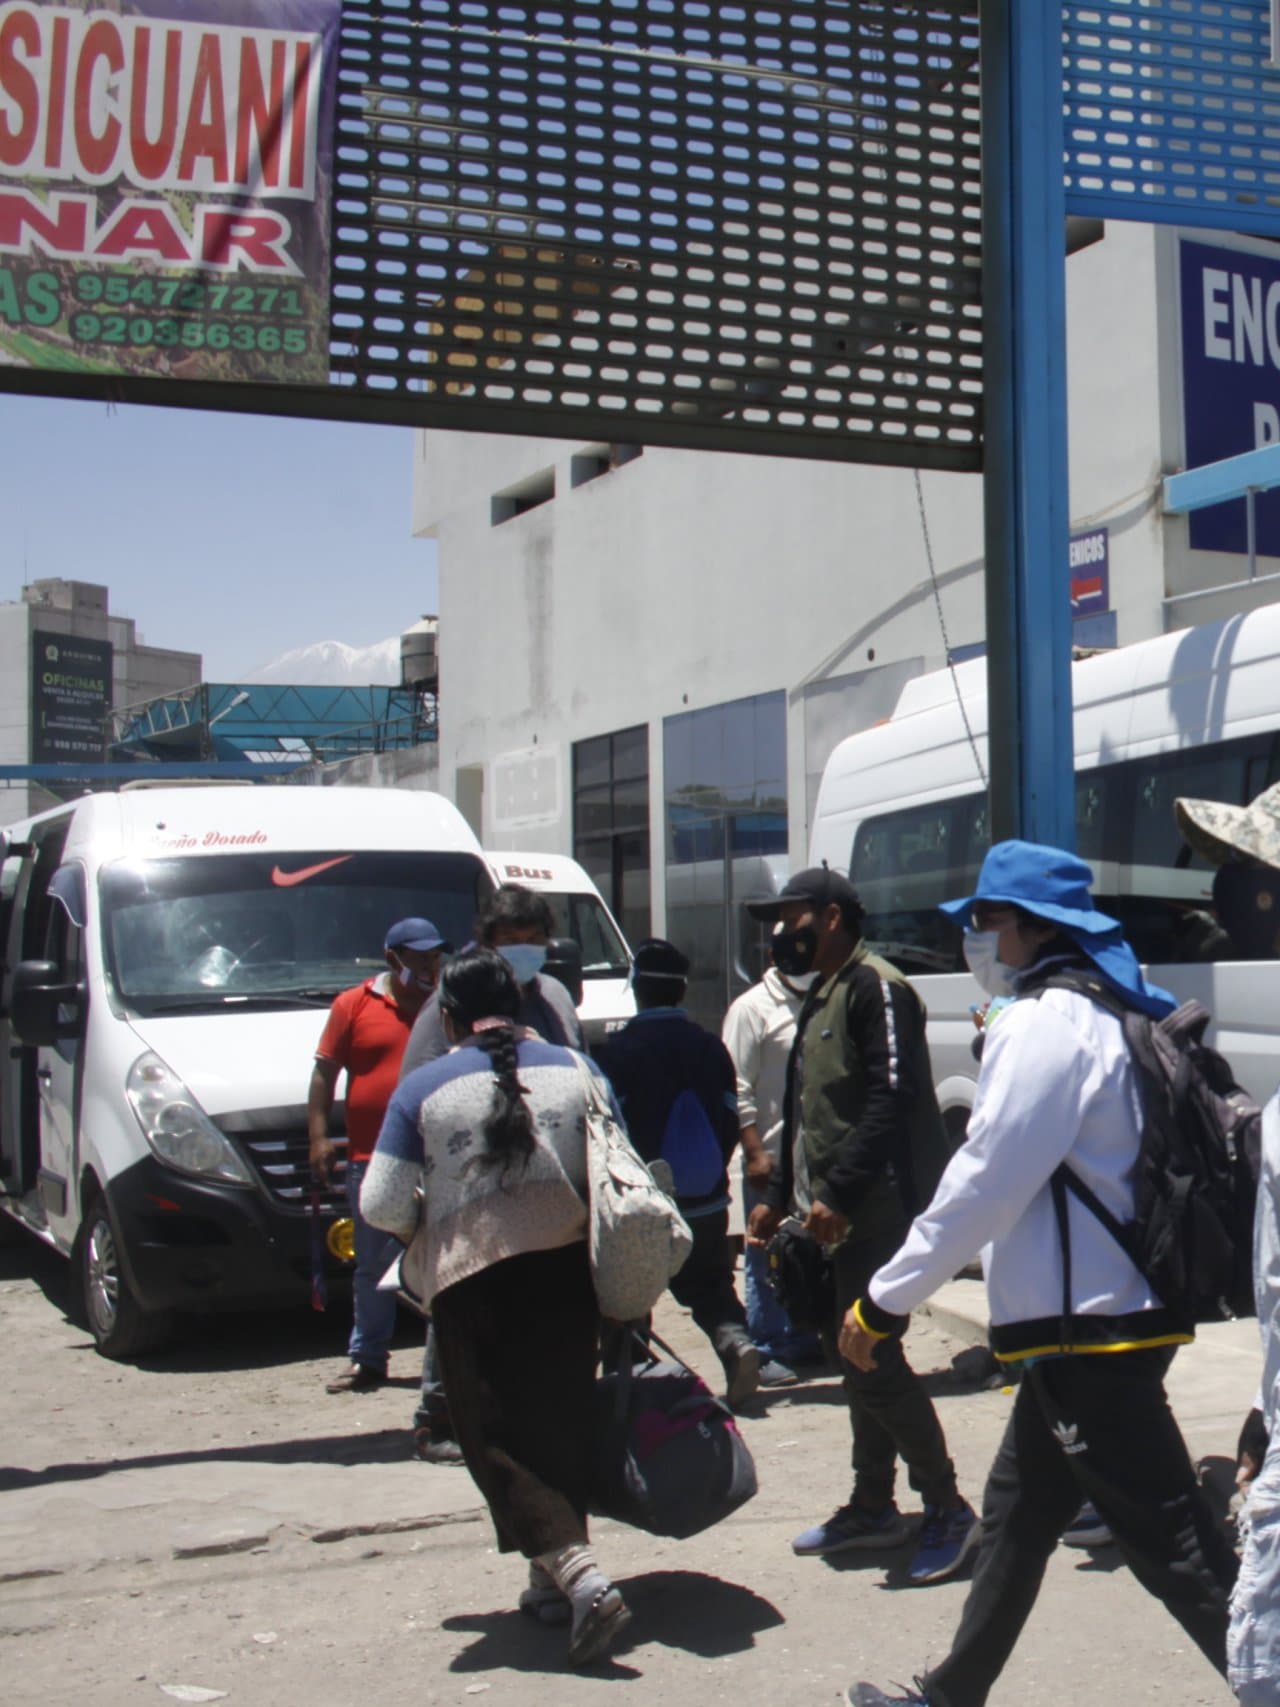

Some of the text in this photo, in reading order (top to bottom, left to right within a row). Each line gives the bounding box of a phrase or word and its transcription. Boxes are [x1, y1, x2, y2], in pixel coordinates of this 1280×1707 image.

[0, 10, 312, 190] SICUANI
[75, 313, 307, 353] 920356365
[504, 865, 553, 880] Bus
